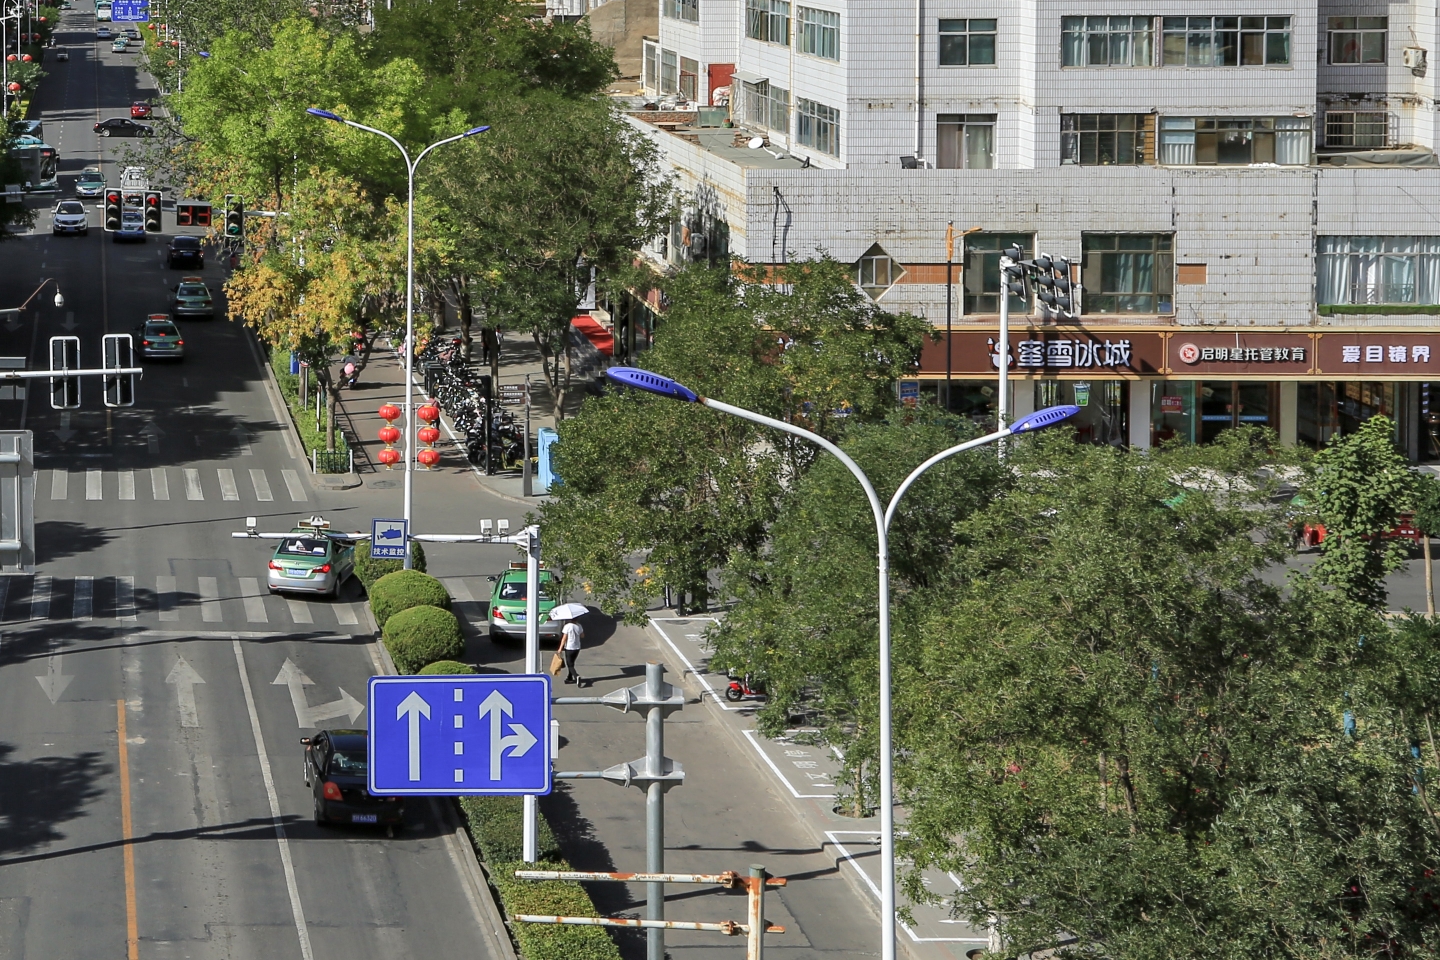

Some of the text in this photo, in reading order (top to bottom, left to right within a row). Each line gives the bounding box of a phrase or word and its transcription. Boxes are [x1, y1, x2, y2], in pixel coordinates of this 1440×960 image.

[1017, 339, 1130, 367] 蜜雪冰城
[1200, 347, 1305, 362] 启明星托管教育
[1342, 345, 1431, 364] 爱目镜界
[373, 547, 405, 556] 技术监控
